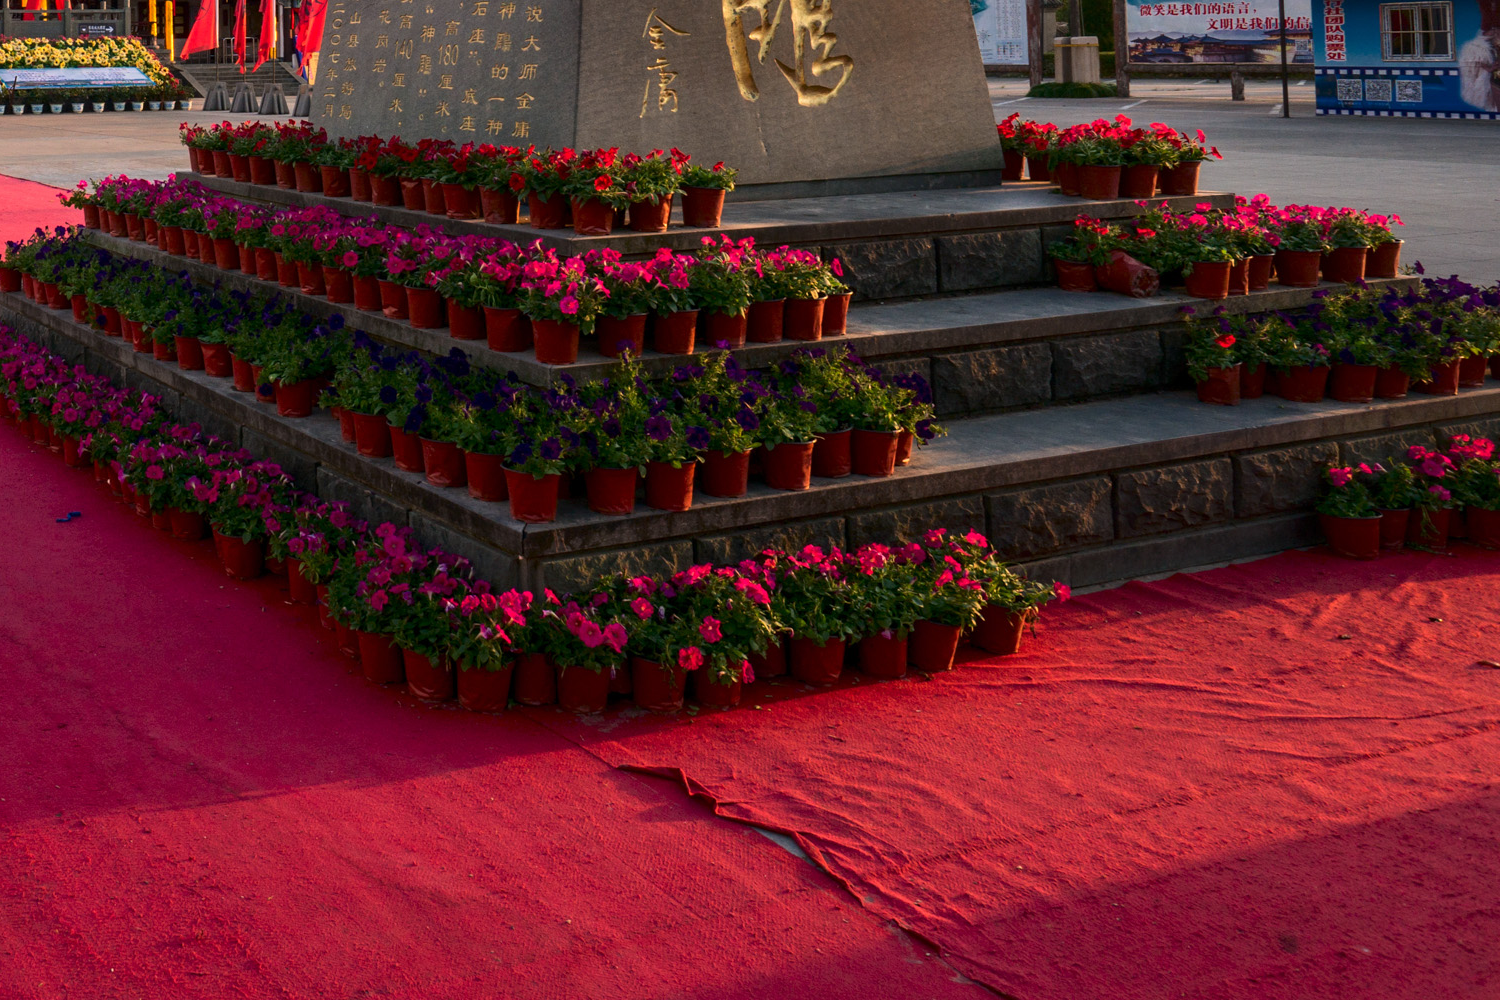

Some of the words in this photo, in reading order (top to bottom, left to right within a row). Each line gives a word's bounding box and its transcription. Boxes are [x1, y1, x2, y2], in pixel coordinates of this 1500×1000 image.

[1139, 2, 1258, 17] 微笑是我们的语言，
[639, 8, 691, 118] 金庸
